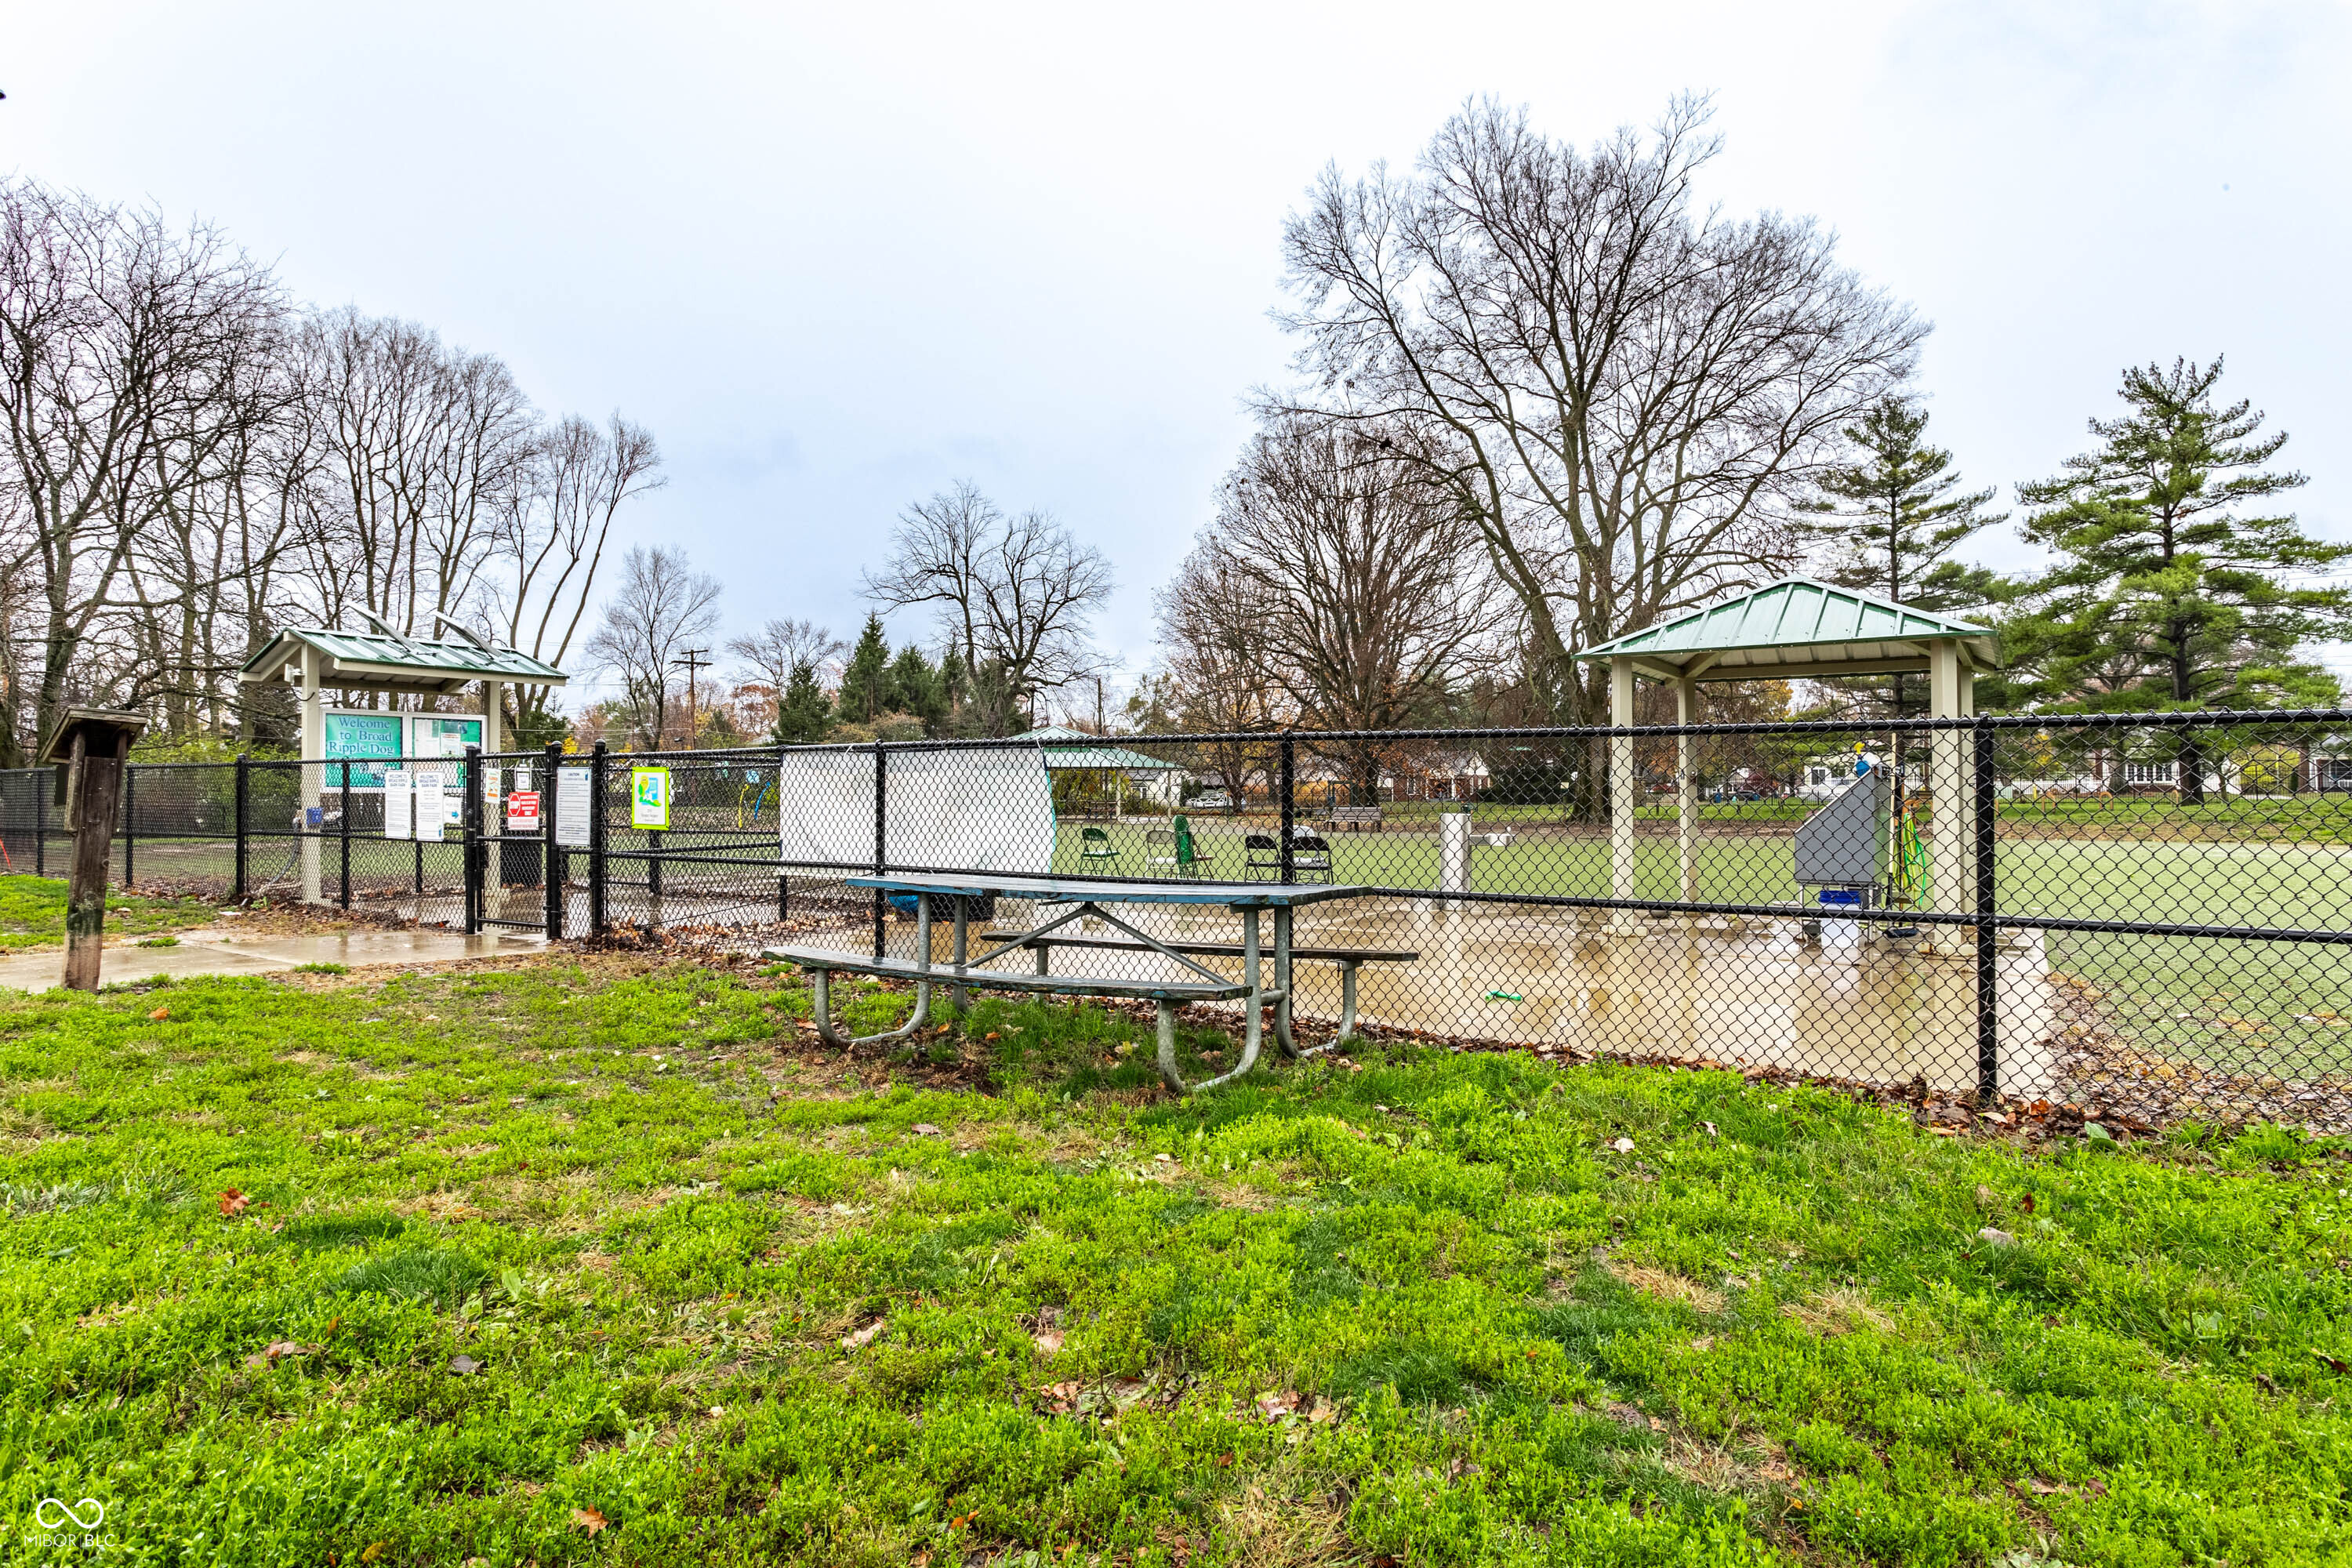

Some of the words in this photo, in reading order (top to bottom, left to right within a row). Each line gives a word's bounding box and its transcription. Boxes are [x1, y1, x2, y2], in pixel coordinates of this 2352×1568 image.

[339, 717, 390, 729] Welcome
[340, 731, 351, 740] to
[359, 730, 392, 742] Broad
[329, 741, 367, 754] Ripple
[370, 744, 394, 757] Dog
[510, 800, 520, 809] STOP
